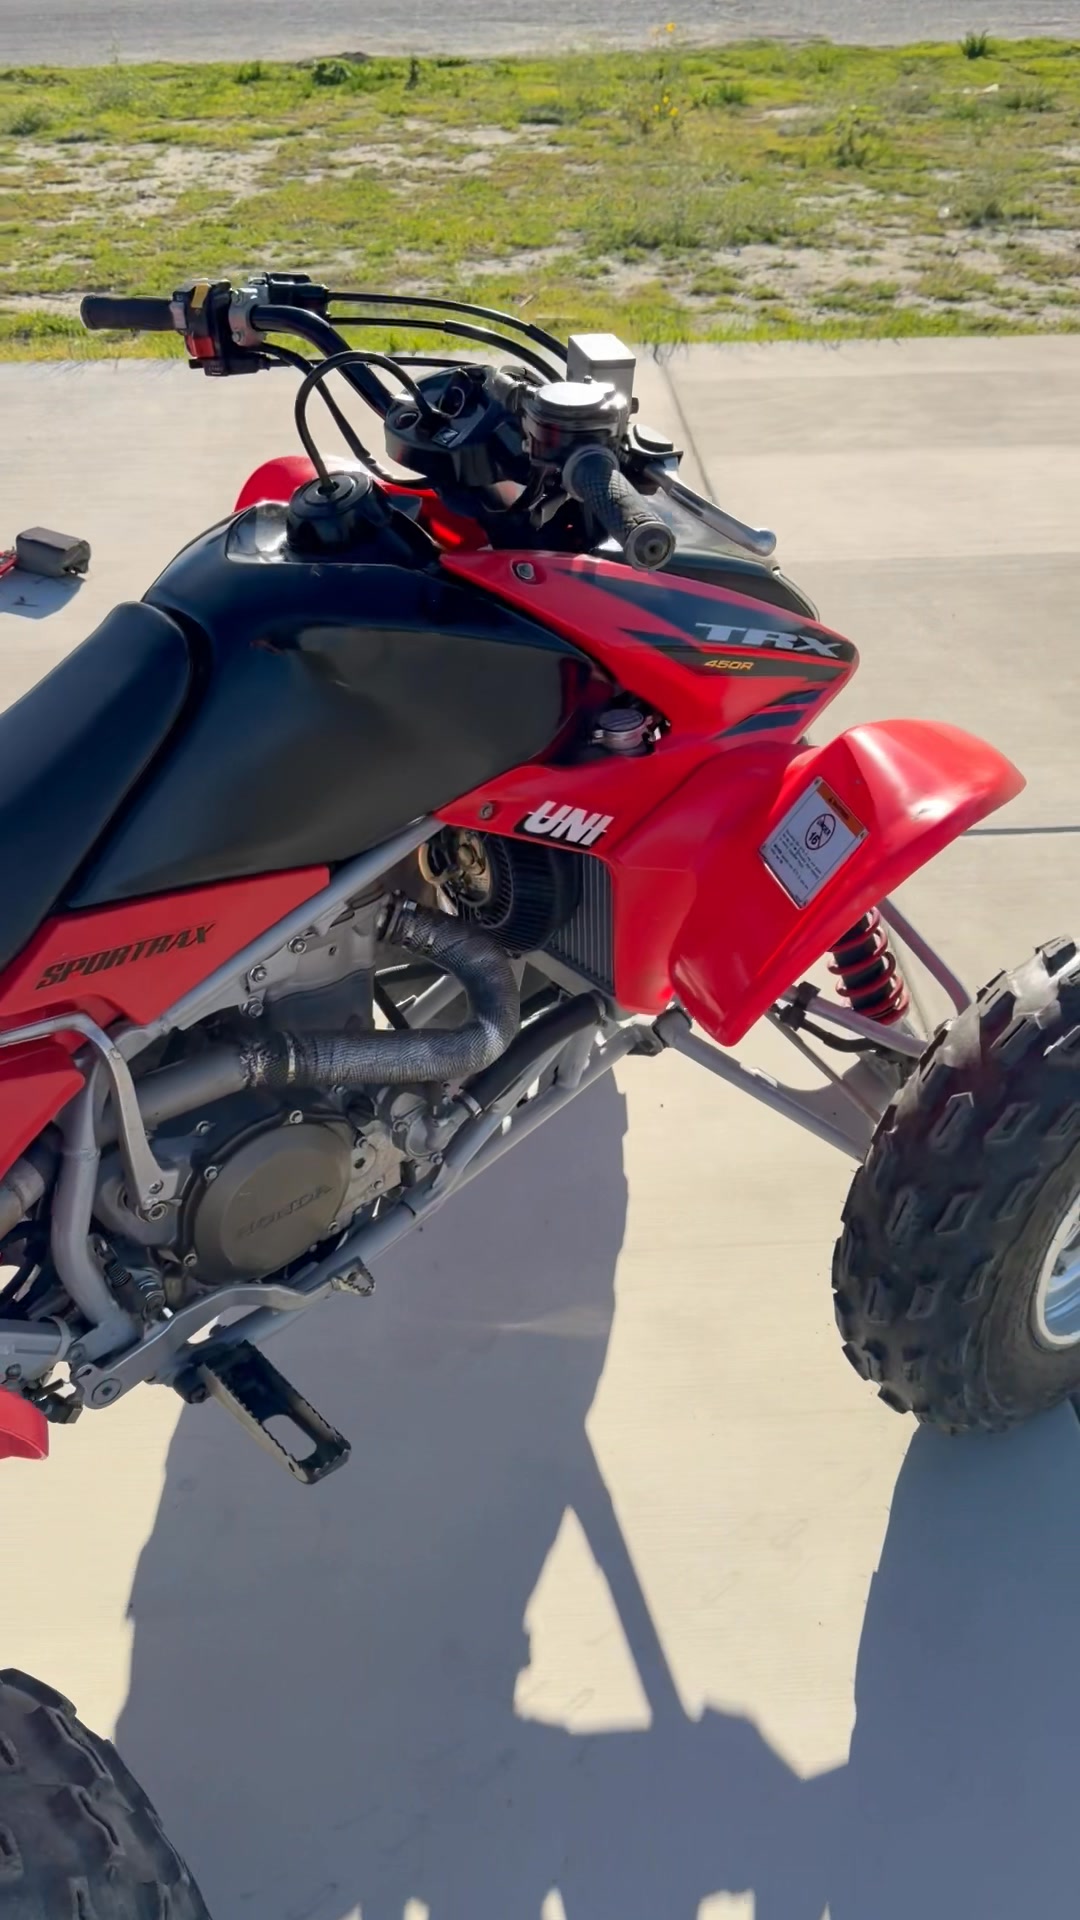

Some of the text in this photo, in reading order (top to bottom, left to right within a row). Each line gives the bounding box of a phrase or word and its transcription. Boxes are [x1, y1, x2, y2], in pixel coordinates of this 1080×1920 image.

[695, 622, 842, 658] TRX
[704, 660, 754, 670] 450R
[523, 800, 615, 846] UNI
[35, 921, 217, 990] SPORTRAX
